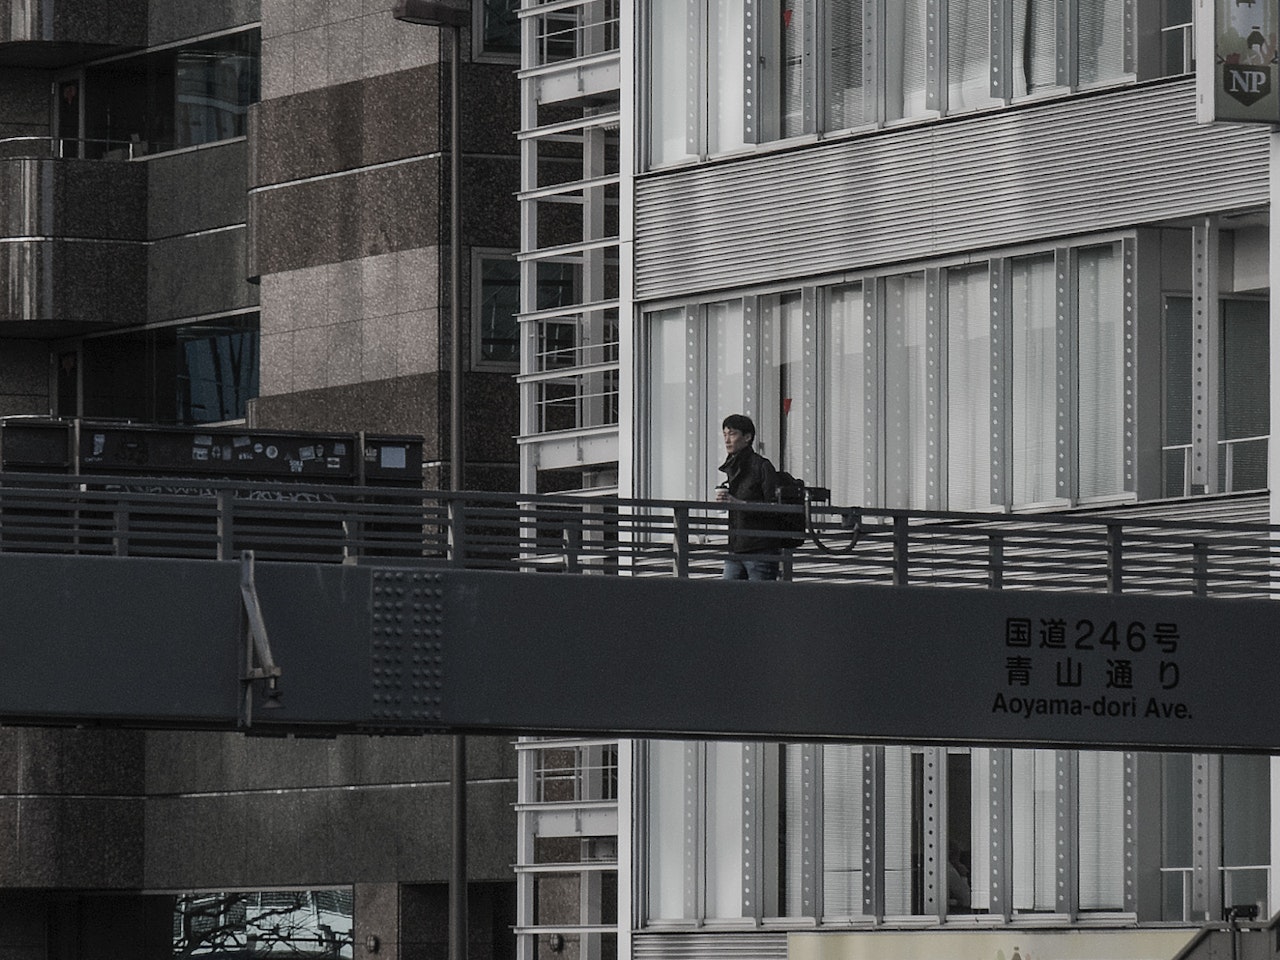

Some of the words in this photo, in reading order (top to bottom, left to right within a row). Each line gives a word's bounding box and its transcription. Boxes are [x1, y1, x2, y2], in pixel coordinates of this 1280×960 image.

[1229, 69, 1267, 93] NP
[1005, 617, 1180, 654] 国道246号
[1005, 656, 1180, 690] 青山通り
[992, 693, 1136, 719] Aoyama-dori
[1145, 698, 1193, 720] Ave.
